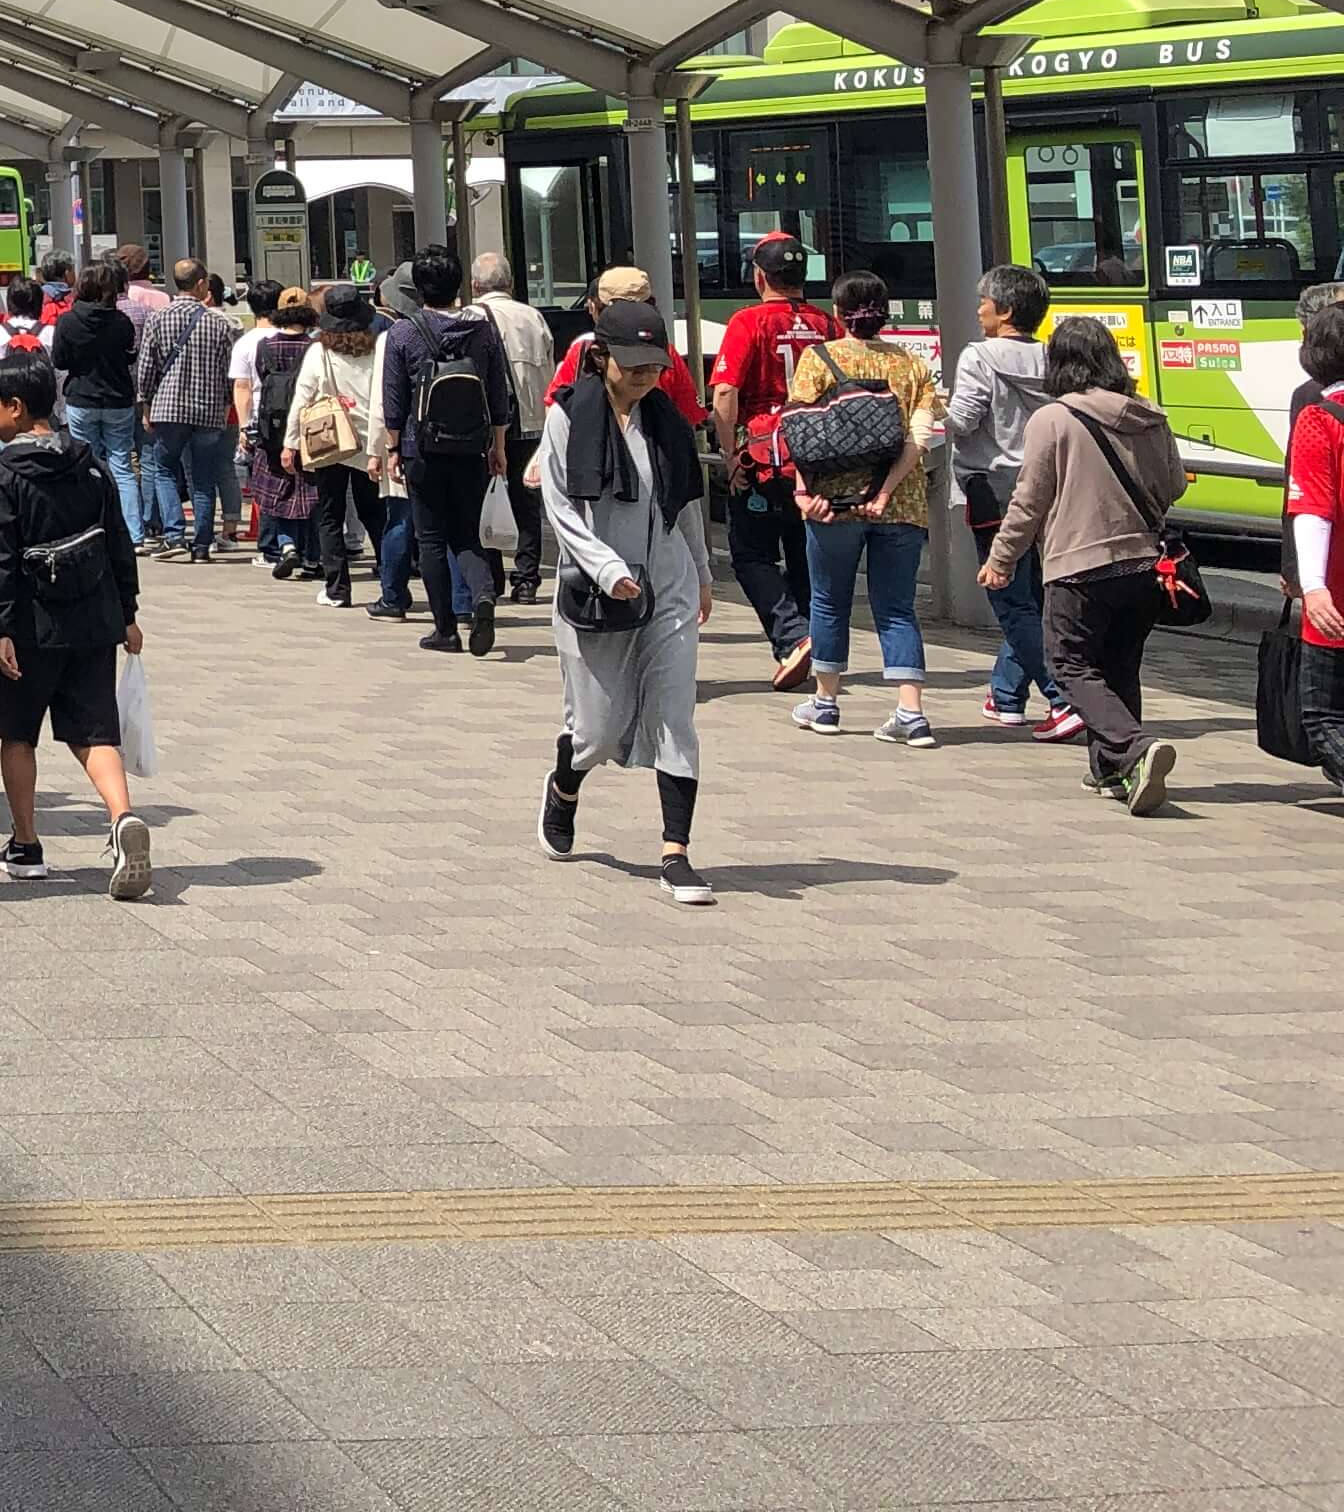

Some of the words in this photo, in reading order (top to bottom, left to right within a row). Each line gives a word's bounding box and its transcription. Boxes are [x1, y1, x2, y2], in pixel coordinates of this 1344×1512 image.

[833, 66, 926, 91] KOKUS
[1008, 48, 1119, 77] KOGYO
[1158, 38, 1233, 65] BUS
[1172, 254, 1193, 266] NBA
[1211, 303, 1237, 317] 入口
[1208, 318, 1241, 327] ENTRANCE
[1197, 343, 1237, 354] PASMO
[1199, 357, 1237, 369] Suica
